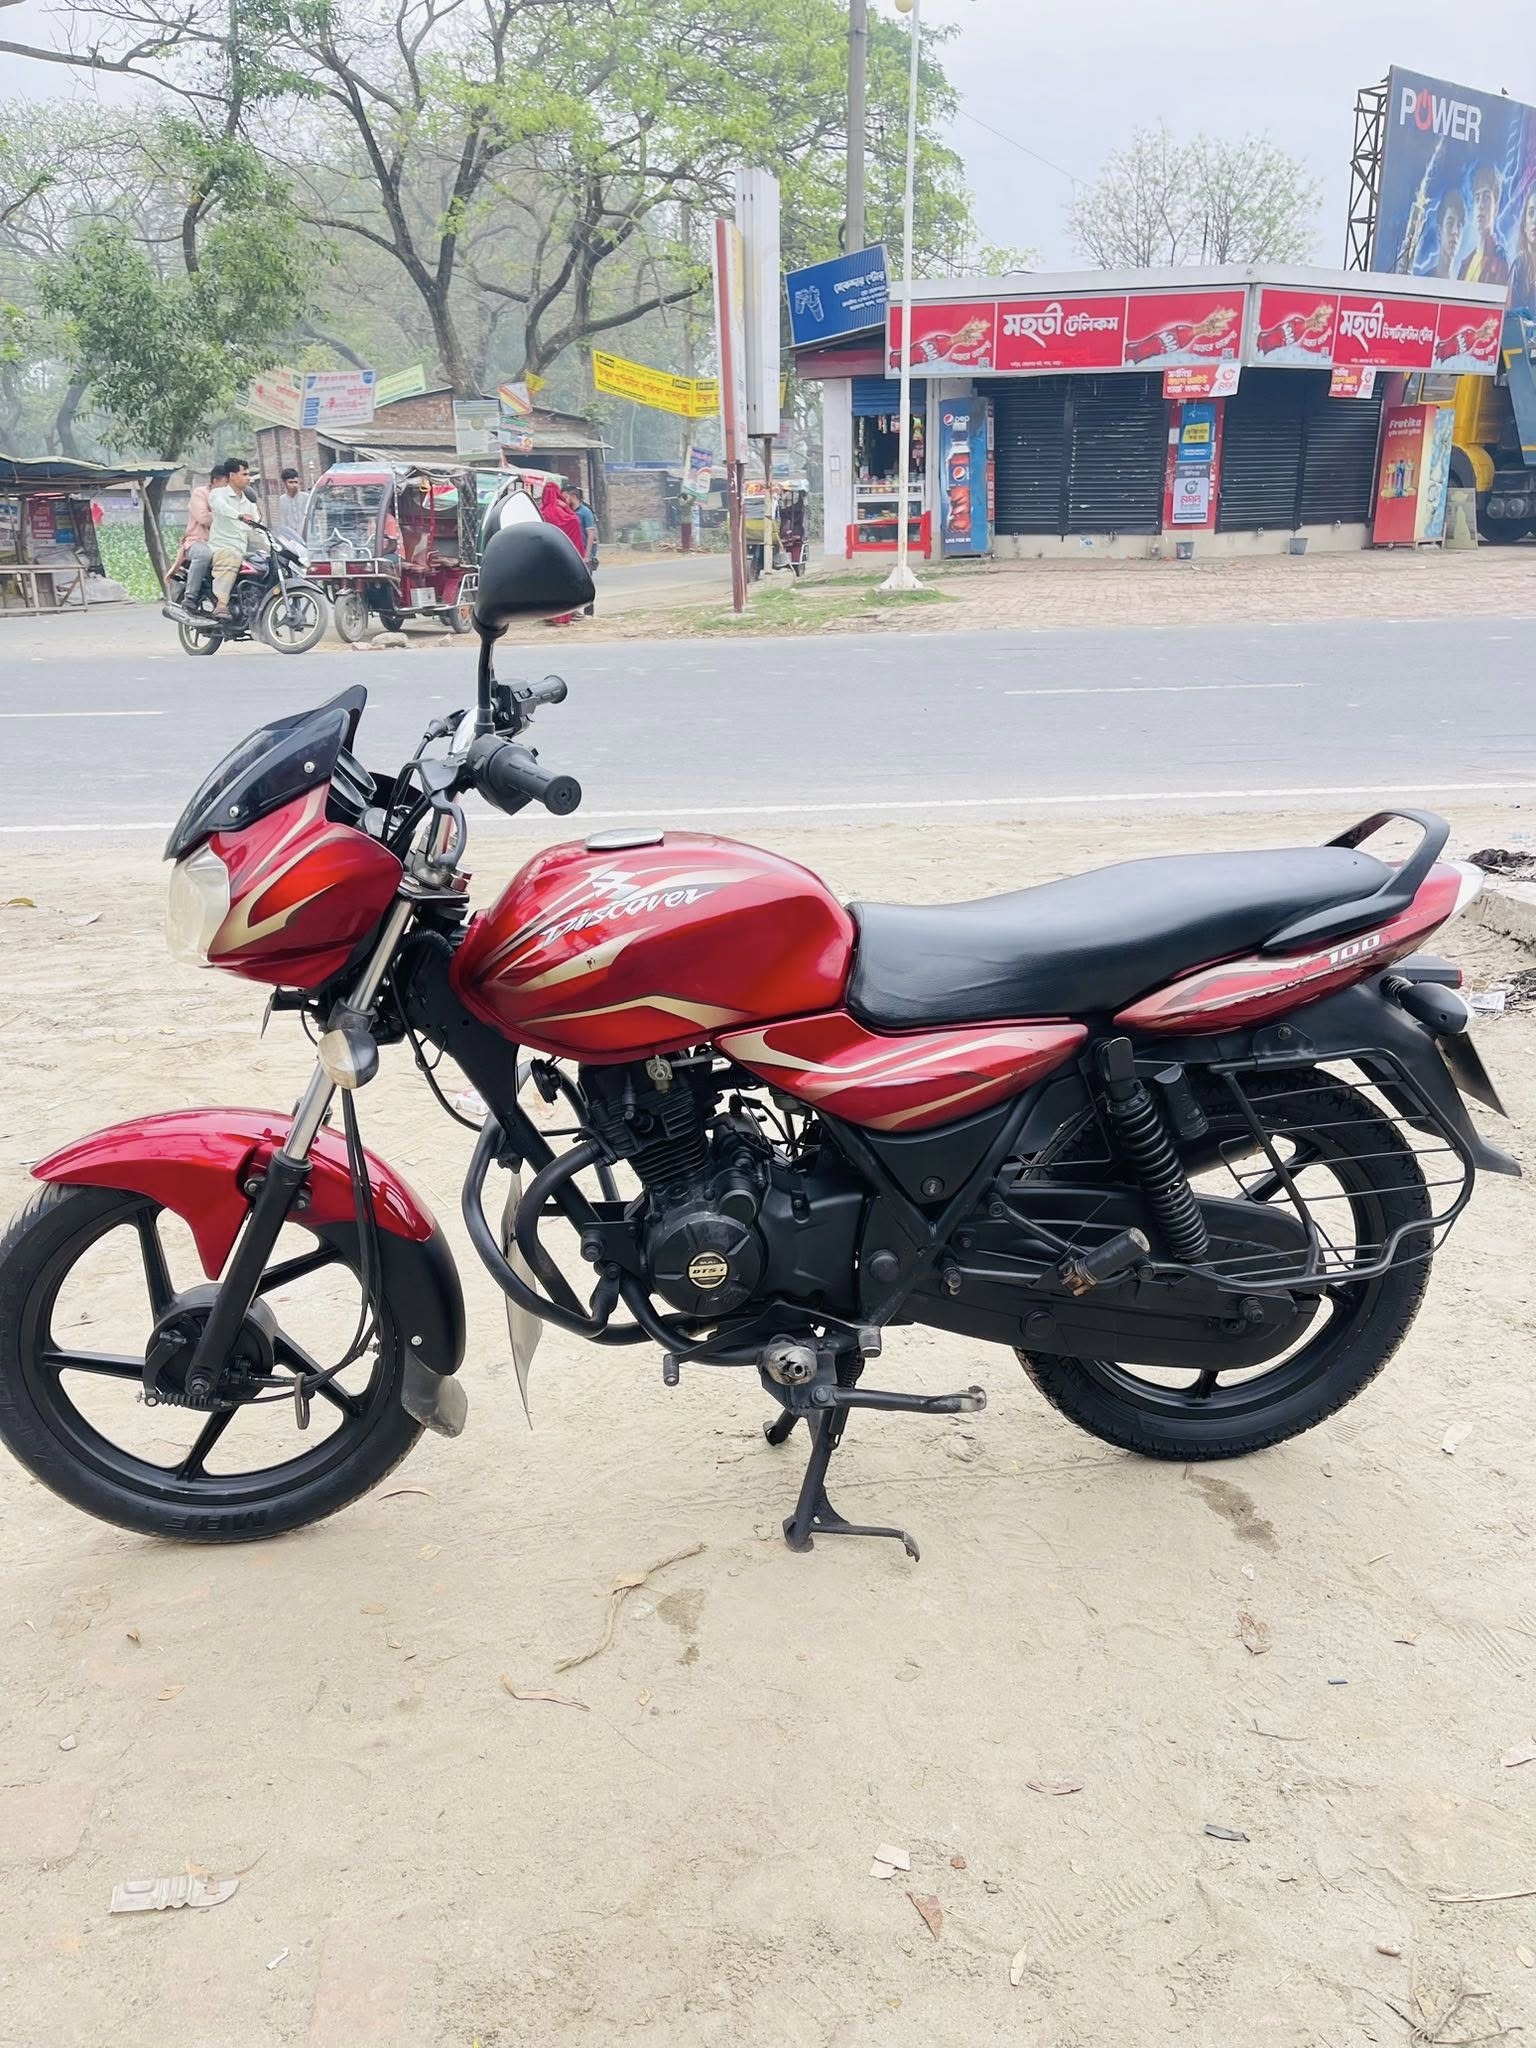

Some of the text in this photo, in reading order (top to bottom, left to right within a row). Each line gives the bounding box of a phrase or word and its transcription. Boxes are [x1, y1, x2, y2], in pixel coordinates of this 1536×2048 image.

[1399, 87, 1482, 144] POWER
[1003, 302, 1119, 349] মহতী টেলিকম
[1339, 301, 1385, 353] মহতী
[1389, 416, 1422, 429] Frutika
[539, 888, 716, 949] Discover
[1328, 934, 1381, 965] 100
